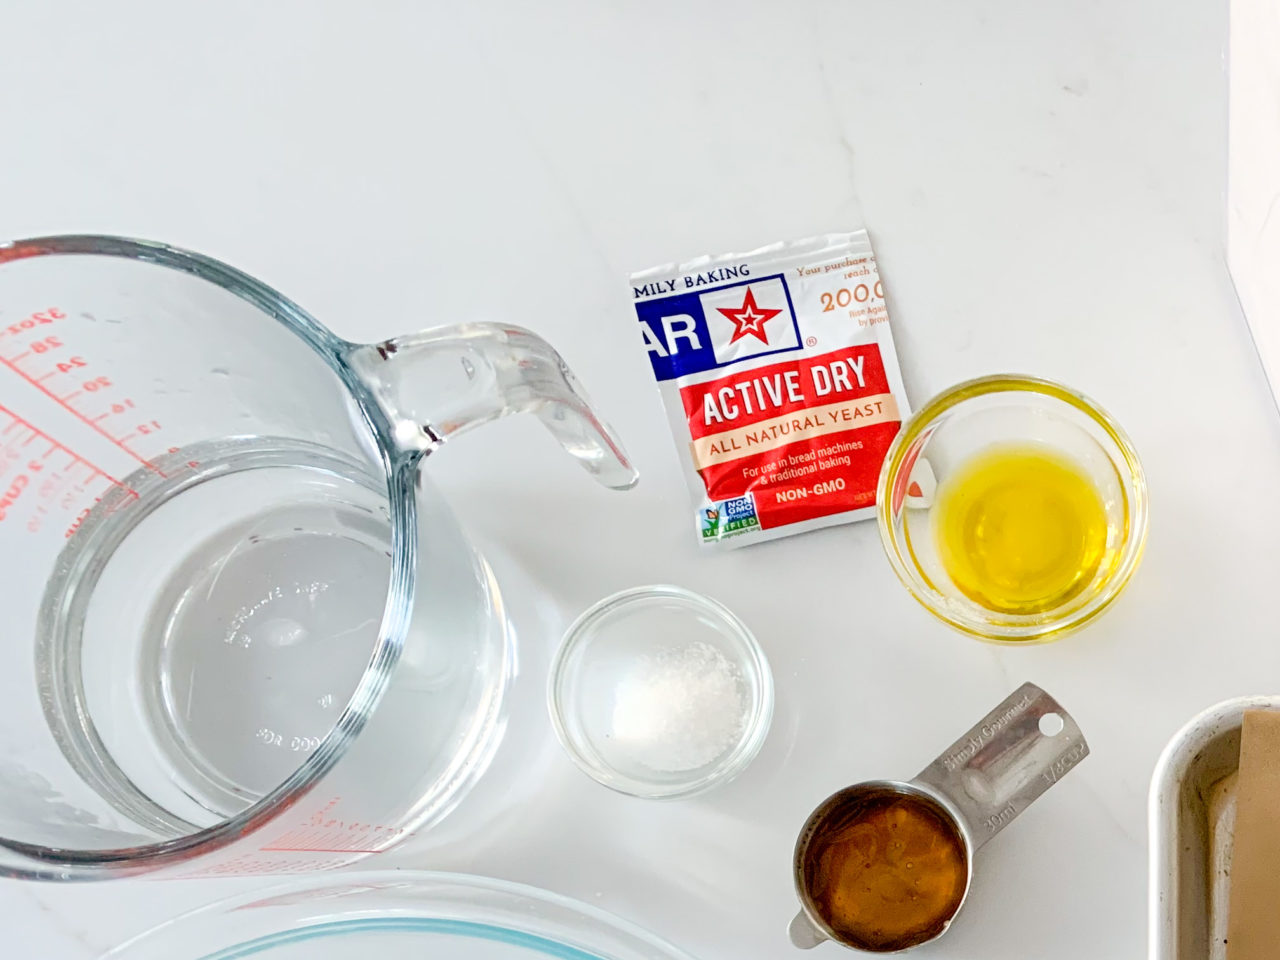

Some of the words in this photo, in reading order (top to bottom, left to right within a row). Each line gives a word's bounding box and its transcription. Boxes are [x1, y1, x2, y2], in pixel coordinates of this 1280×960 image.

[684, 265, 750, 289] BAKING
[797, 266, 821, 277] Your
[824, 257, 867, 272] purchase
[843, 266, 870, 279] reach
[703, 370, 805, 426] ACTIVE
[810, 355, 866, 397] DRY
[709, 437, 743, 456] ALL
[745, 414, 825, 447] NATURAL
[828, 401, 883, 424] YEAST
[742, 466, 759, 479] For
[760, 461, 777, 474] use
[778, 459, 788, 467] in
[788, 449, 817, 466] bread
[817, 440, 864, 459] machines
[760, 475, 769, 486] &
[769, 463, 818, 484] traditional
[819, 455, 852, 471] baking
[776, 477, 846, 503] NON-GMO
[728, 504, 753, 514] GMO
